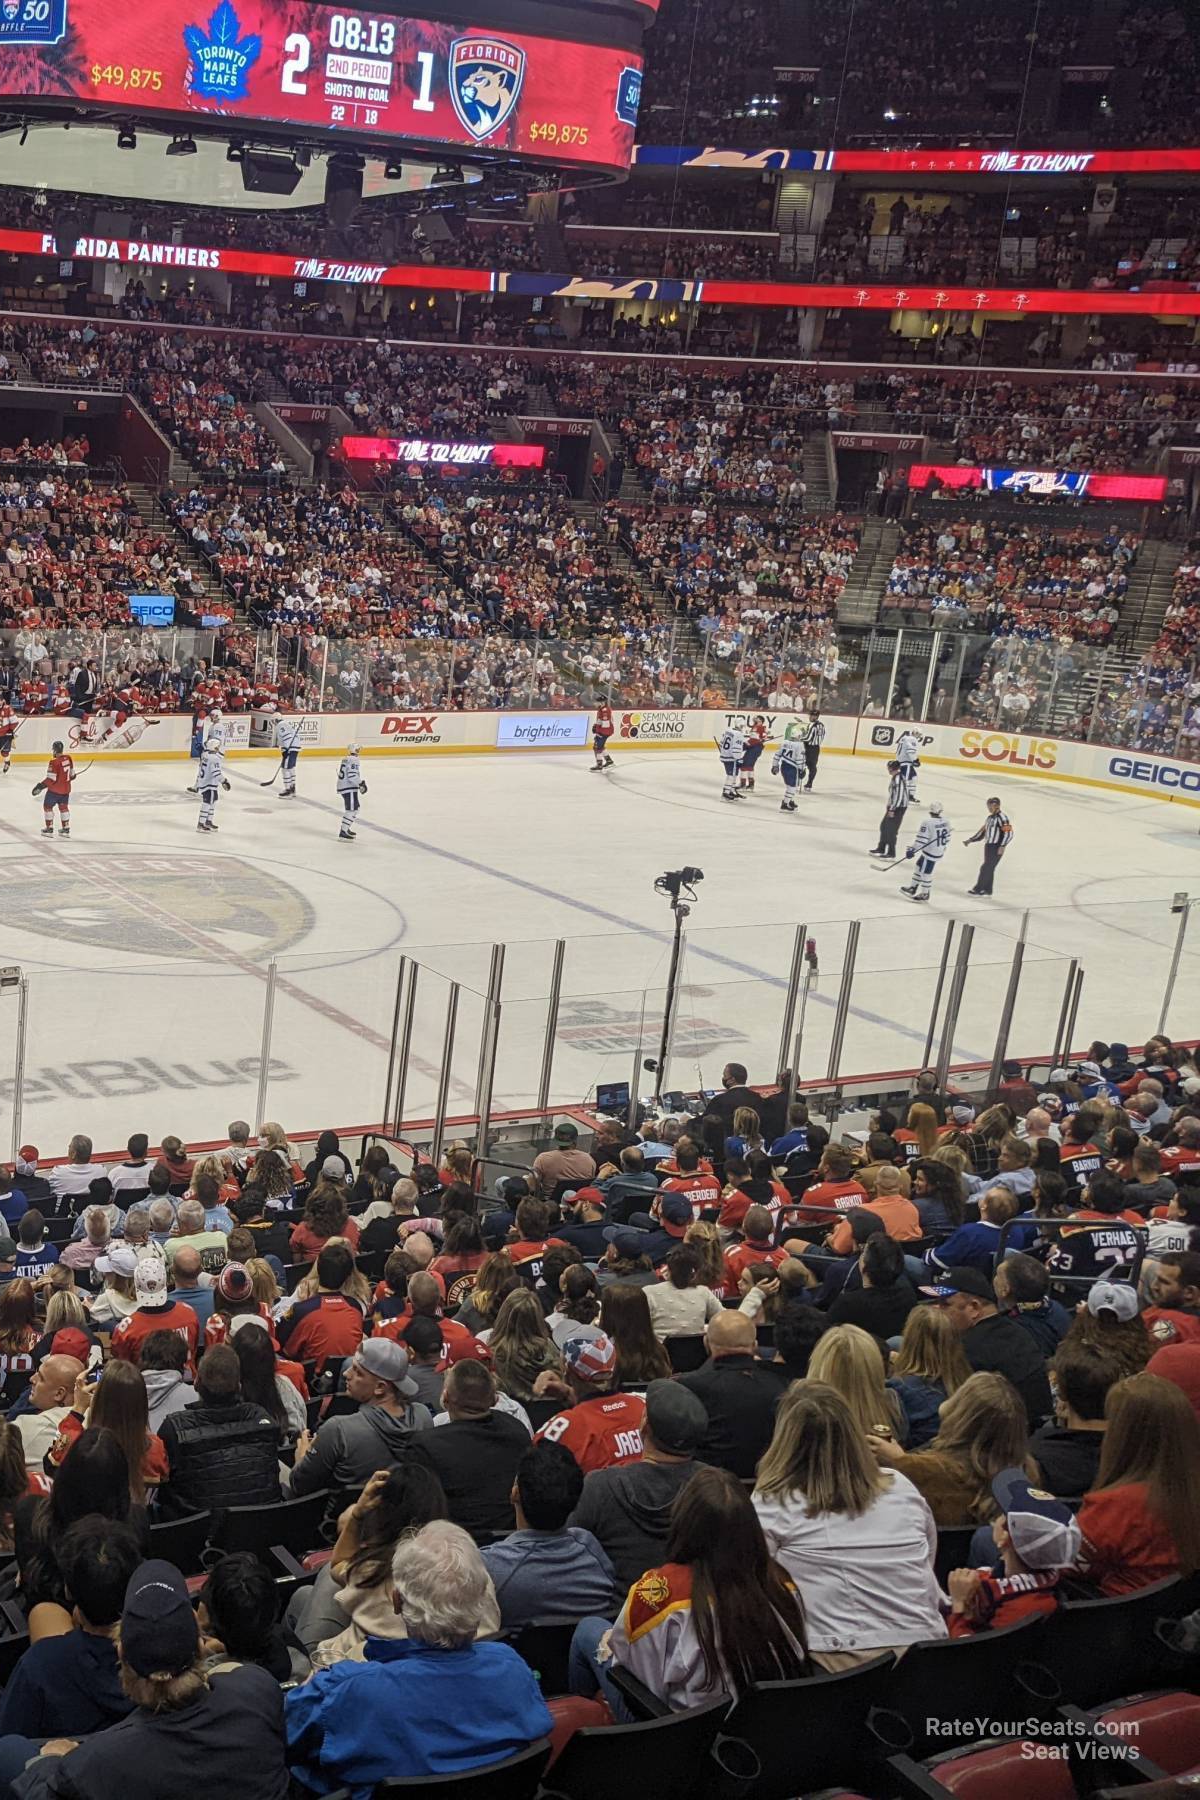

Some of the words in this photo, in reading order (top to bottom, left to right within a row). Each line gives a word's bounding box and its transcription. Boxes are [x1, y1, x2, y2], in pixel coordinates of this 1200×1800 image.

[22, 0, 50, 22] 50
[328, 14, 396, 55] 08:13
[196, 46, 248, 69] TORONTO
[281, 33, 311, 95] 2
[460, 45, 515, 66] FLORIDA
[90, 64, 163, 91] $49,875
[203, 61, 238, 76] MAPLE
[328, 58, 350, 74] 2ND
[351, 62, 389, 81] PERIOD
[203, 74, 237, 87] LEAFS
[412, 51, 435, 112] 1
[324, 83, 353, 98] SHOTS
[354, 86, 367, 99] ON
[368, 87, 390, 102] GOAL
[331, 105, 345, 121] 22
[364, 108, 379, 125] 18
[528, 121, 589, 145] $49,875
[980, 151, 1019, 171] TIME
[1019, 155, 1046, 171] TO
[1044, 154, 1095, 171] HUNT
[42, 234, 120, 260] FLRIDA
[127, 242, 220, 268] PANTHERS
[293, 257, 326, 278] TIME
[326, 265, 347, 280] TO
[345, 266, 387, 283] HUNT
[311, 409, 327, 421] 104
[567, 423, 582, 434] 105
[398, 440, 430, 462] TIME
[430, 444, 451, 462] TO
[448, 445, 494, 463] HUNT
[837, 436, 855, 448] 105
[897, 438, 916, 450] 107
[130, 605, 174, 616] GEICO
[380, 716, 439, 734] DEX
[643, 712, 686, 722] SEMINOLE
[513, 722, 572, 740] brightline
[641, 722, 685, 733] CASINO
[392, 733, 442, 744] imaging
[959, 730, 1058, 769] SOLIS
[1108, 756, 1200, 791] GEICO
[1071, 1158, 1100, 1172] BARKOV
[834, 1193, 864, 1209] BARKOV
[602, 1401, 628, 1412] Reebok
